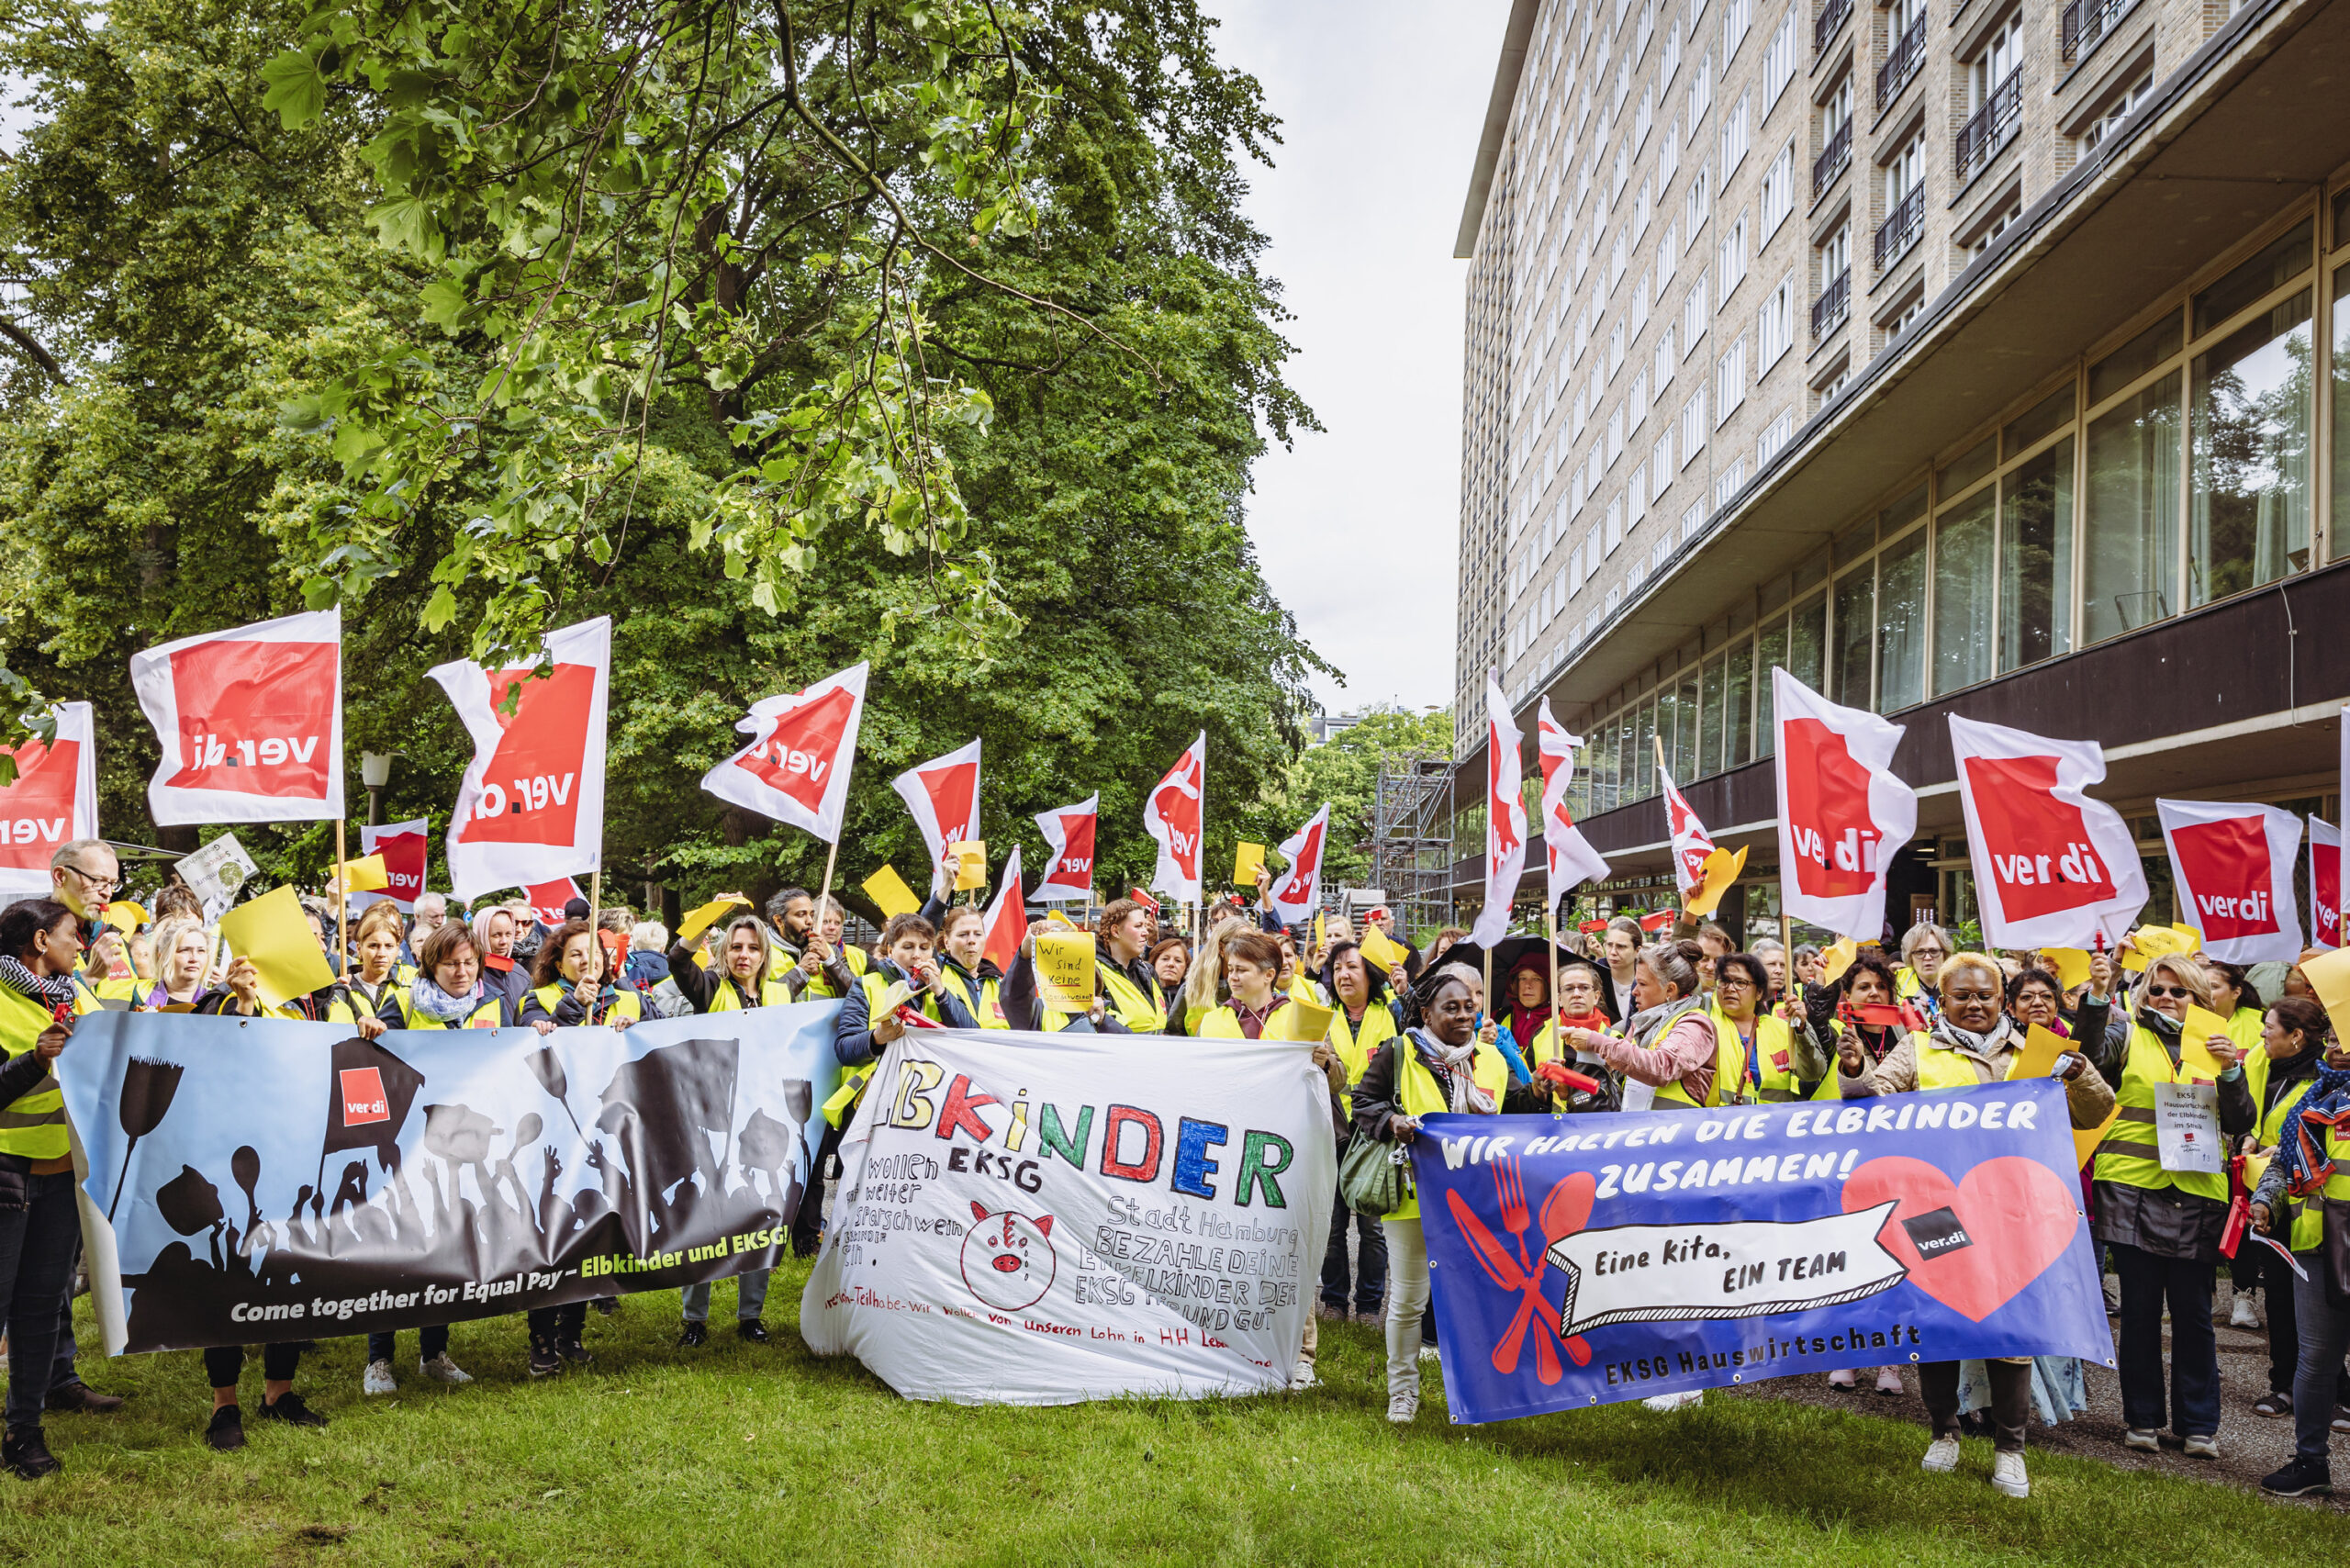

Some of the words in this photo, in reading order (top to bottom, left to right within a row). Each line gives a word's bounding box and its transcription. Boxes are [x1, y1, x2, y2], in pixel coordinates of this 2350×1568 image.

[1994, 842, 2102, 886] ver.di
[1038, 942, 1065, 956] Wir
[347, 1100, 386, 1114] ver.di
[1440, 1135, 1516, 1171] WIR
[1524, 1122, 1682, 1157] HALTEN
[1695, 1112, 1772, 1144] DIE
[1786, 1100, 2039, 1138] ELBKINDER
[947, 1148, 1042, 1193] EKSG
[1595, 1148, 1860, 1199] ZUSAMMEN!
[1107, 1195, 1192, 1235] Stadt
[1199, 1211, 1298, 1256] Hamburg
[1918, 1230, 1966, 1251] ver.di
[1094, 1225, 1224, 1272] BEZAHLE
[1595, 1249, 1650, 1277] Eine
[230, 1302, 305, 1322] Come
[311, 1289, 420, 1320] together
[423, 1283, 459, 1305] for
[463, 1271, 523, 1304] Equal
[527, 1270, 564, 1290] Pay
[581, 1249, 683, 1278] Elbkinder
[688, 1237, 728, 1263] und
[732, 1225, 789, 1254] EKSG!
[1075, 1275, 1136, 1305] EKSG
[1723, 1260, 1765, 1294] EIN
[1777, 1249, 1848, 1282] TEAM
[1091, 1326, 1125, 1342] Lohn
[1134, 1330, 1146, 1344] in
[1160, 1327, 1190, 1347] HH
[1606, 1355, 1670, 1386] EKSG
[1680, 1323, 1922, 1373] Hauswirtschaft
